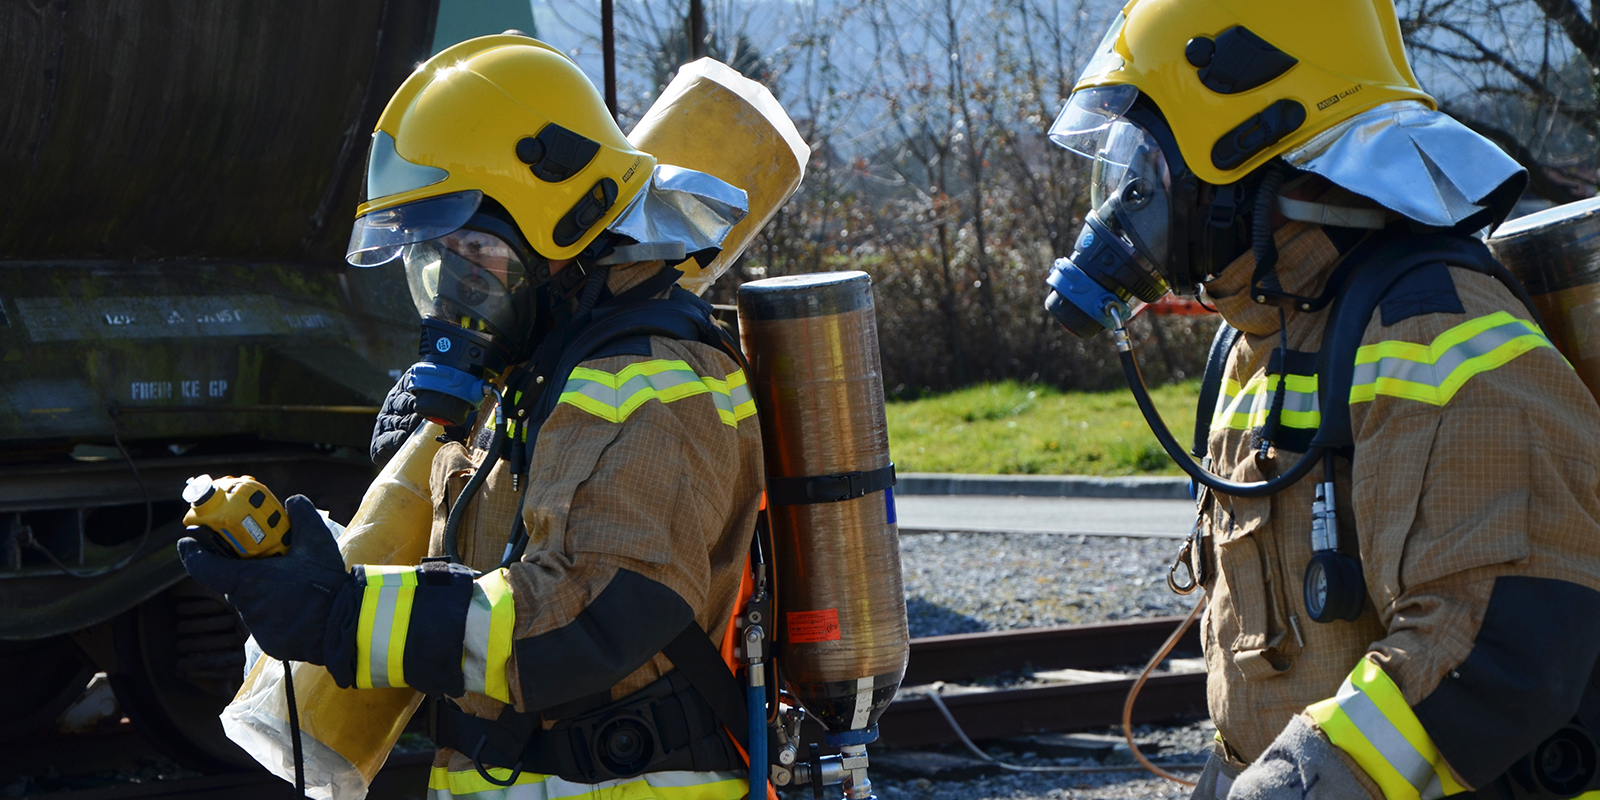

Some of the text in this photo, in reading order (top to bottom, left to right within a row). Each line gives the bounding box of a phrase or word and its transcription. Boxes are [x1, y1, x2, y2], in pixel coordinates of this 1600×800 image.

[1317, 84, 1363, 111] MSA GALLET
[181, 380, 201, 398] KE
[208, 379, 228, 398] GP
